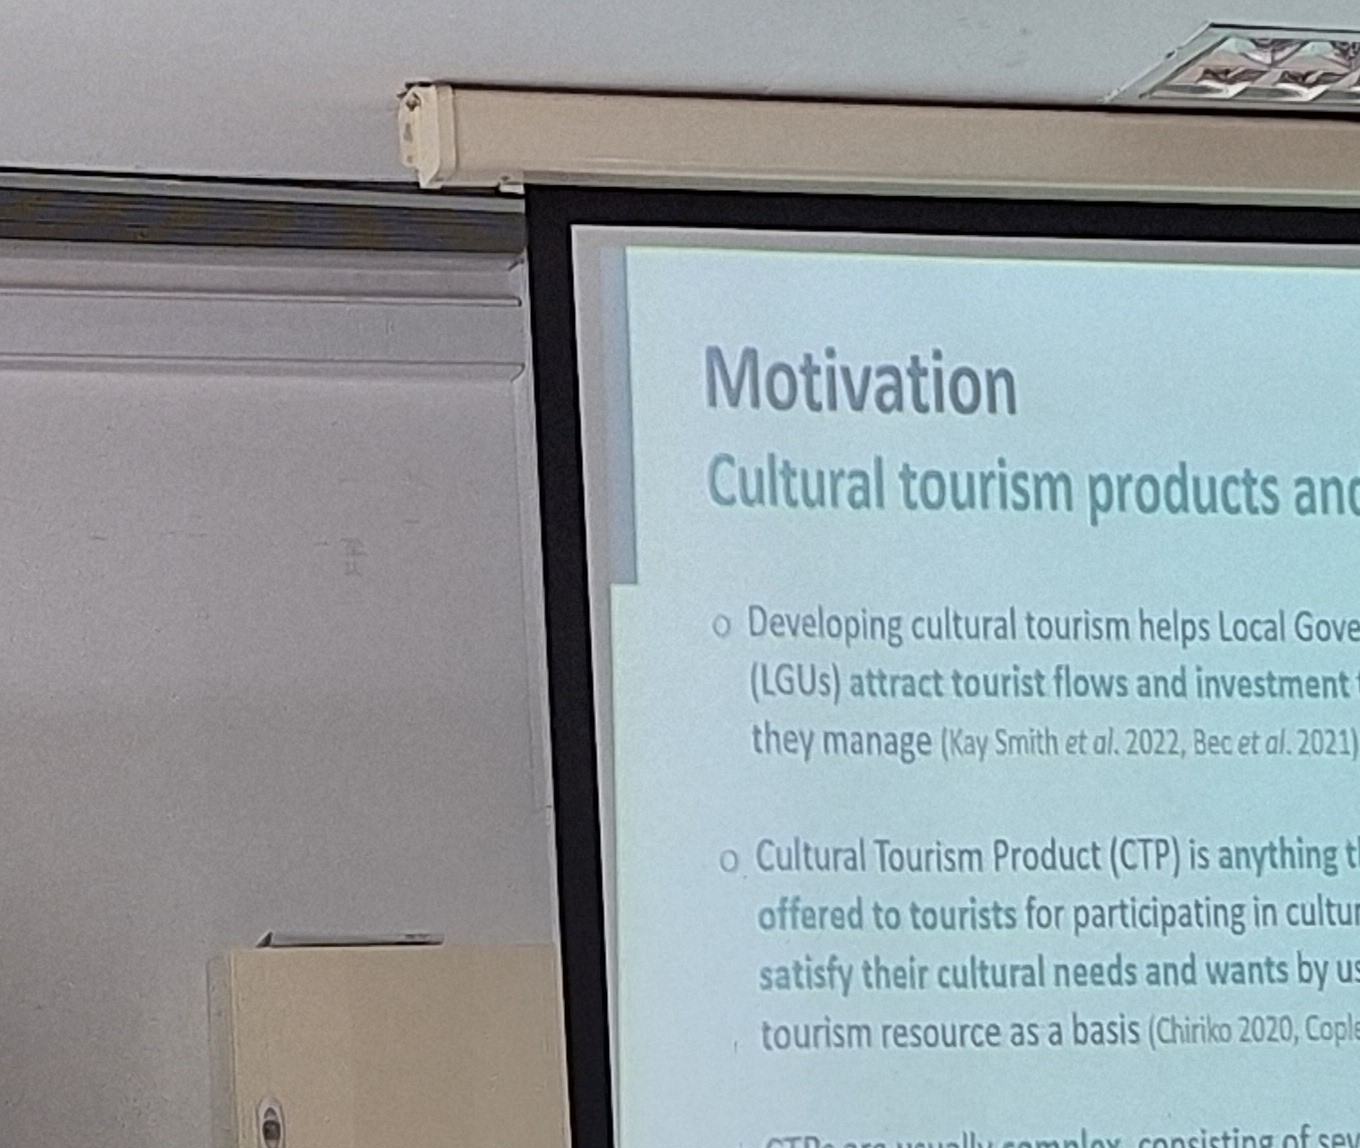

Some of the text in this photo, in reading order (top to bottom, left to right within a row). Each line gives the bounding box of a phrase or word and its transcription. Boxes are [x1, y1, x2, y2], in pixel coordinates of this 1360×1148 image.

[706, 346, 1017, 416] Motivation
[708, 452, 885, 511] Cultural
[898, 456, 1074, 512] tourism
[1088, 460, 1281, 528] products
[748, 604, 904, 649] Developing
[911, 605, 1017, 641] cultural
[1025, 609, 1131, 641] tourism
[1138, 607, 1211, 650] helps
[1218, 608, 1286, 643] Local
[750, 661, 842, 706] (LGUs)
[849, 669, 945, 698] attract
[950, 664, 1047, 698] tourist
[1053, 664, 1129, 698] flows
[1136, 664, 1188, 698] and
[1196, 665, 1351, 699] investment
[752, 719, 1360, 765] they manage (Kay Smith et al. 2022, Bec et al. 2021)
[756, 836, 867, 872] Cultural
[873, 838, 984, 873] Tourism
[993, 836, 1102, 872] Product
[1109, 835, 1181, 879] (CTP)
[1188, 838, 1210, 871] is
[1218, 835, 1339, 878] anything
[758, 895, 865, 931] offered
[872, 901, 902, 931] to
[909, 896, 1018, 931] tourists
[1025, 894, 1065, 930] for
[1073, 895, 1247, 937] participating
[1252, 895, 1278, 928] in
[760, 953, 854, 998] satisfy
[861, 954, 930, 990] their
[937, 953, 1046, 990] cultural
[1054, 952, 1138, 988] needs
[1145, 951, 1197, 987] and
[1205, 956, 1289, 986] wants
[1296, 950, 1330, 992] by
[761, 1015, 873, 1051] tourism
[881, 1022, 1002, 1049] resource
[1010, 1022, 1040, 1047] as
[1047, 1021, 1064, 1047] a
[1071, 1011, 1141, 1046] basis
[1148, 1014, 1233, 1051] (Chiriko
[1238, 1014, 1300, 1046] 2020,
